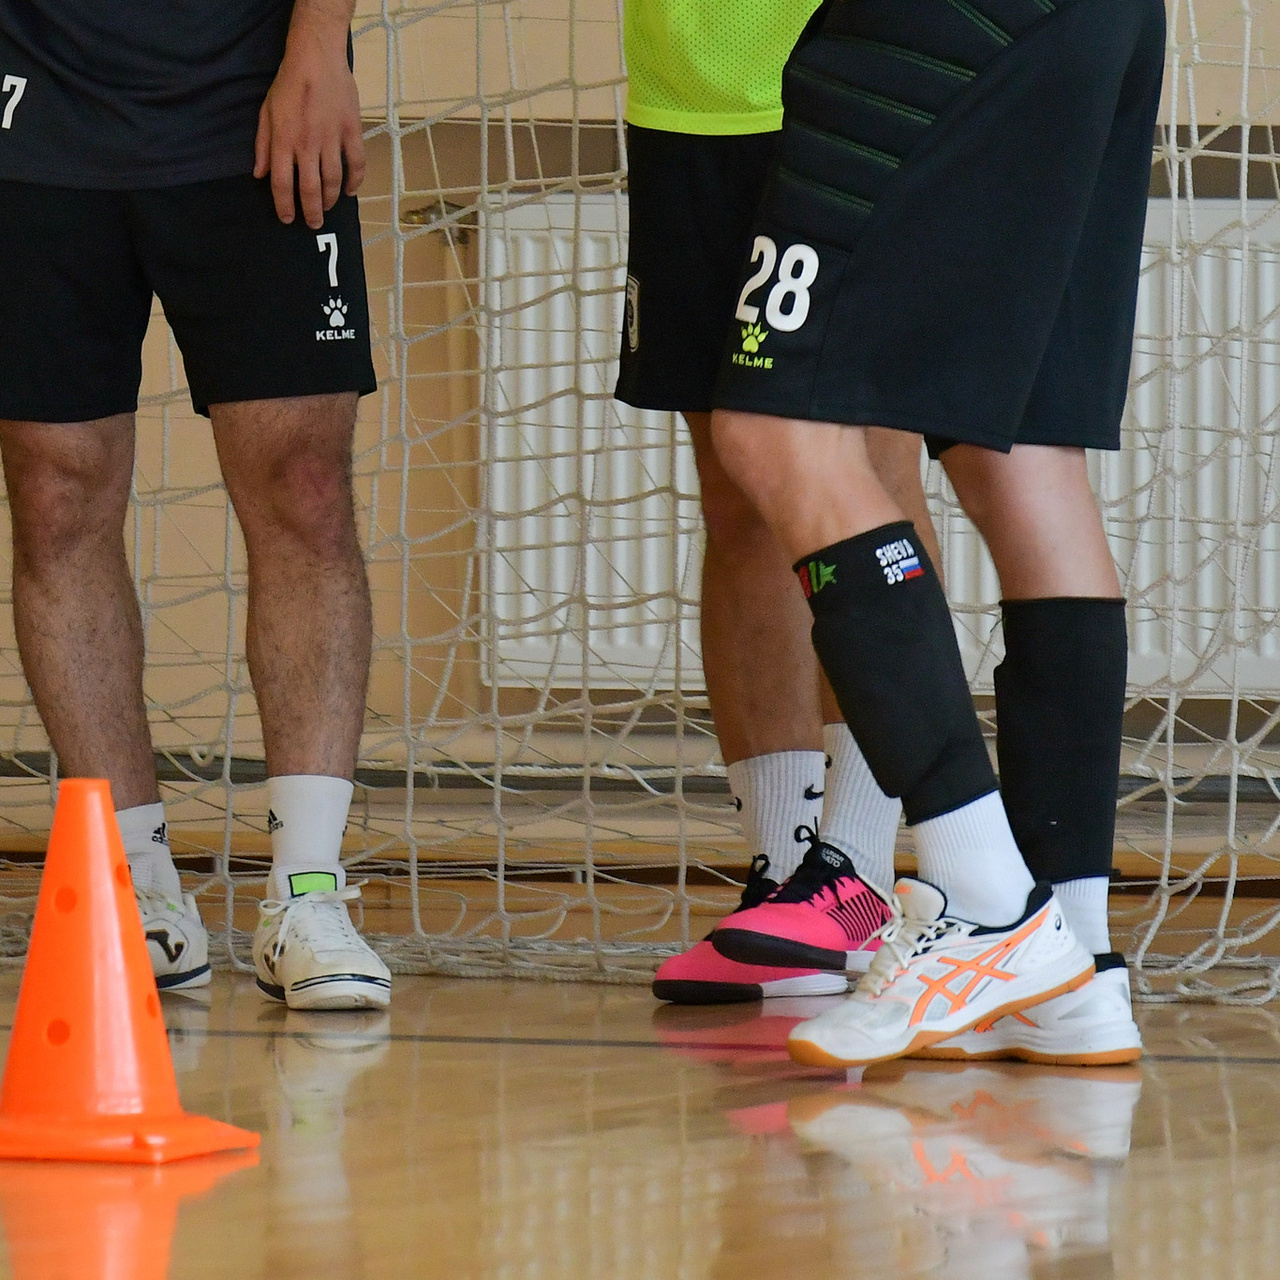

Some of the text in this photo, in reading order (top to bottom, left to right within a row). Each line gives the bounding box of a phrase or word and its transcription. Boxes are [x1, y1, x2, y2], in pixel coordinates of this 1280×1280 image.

[1, 73, 28, 130] 7
[315, 232, 339, 288] 7
[734, 234, 821, 333] 28
[315, 328, 356, 342] KELME
[731, 352, 775, 370] KELME
[874, 538, 916, 567] SHEVA
[883, 563, 906, 586] 35
